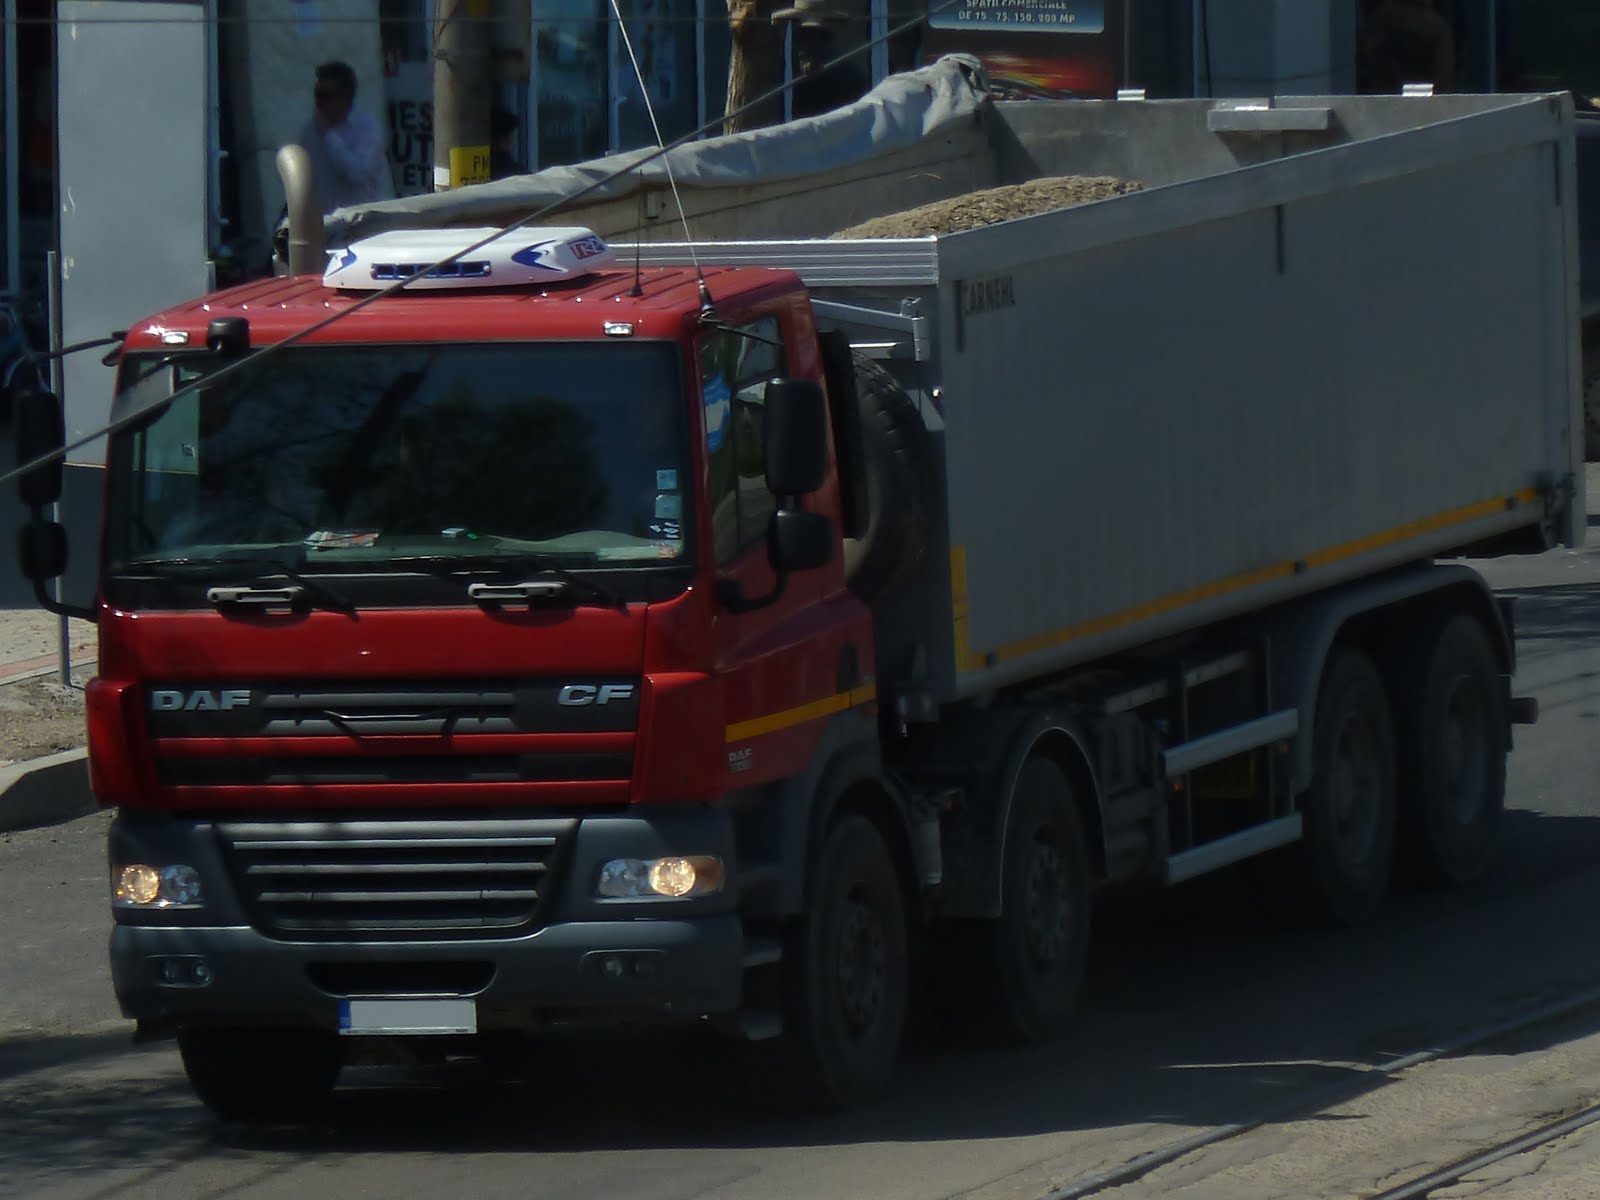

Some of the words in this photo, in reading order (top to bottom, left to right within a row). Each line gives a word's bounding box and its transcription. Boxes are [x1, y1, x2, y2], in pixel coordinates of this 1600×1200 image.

[958, 10, 971, 20] DE
[1059, 13, 1076, 23] MP
[152, 689, 251, 711] DAF
[558, 684, 634, 706] CF
[728, 748, 752, 762] DAF
